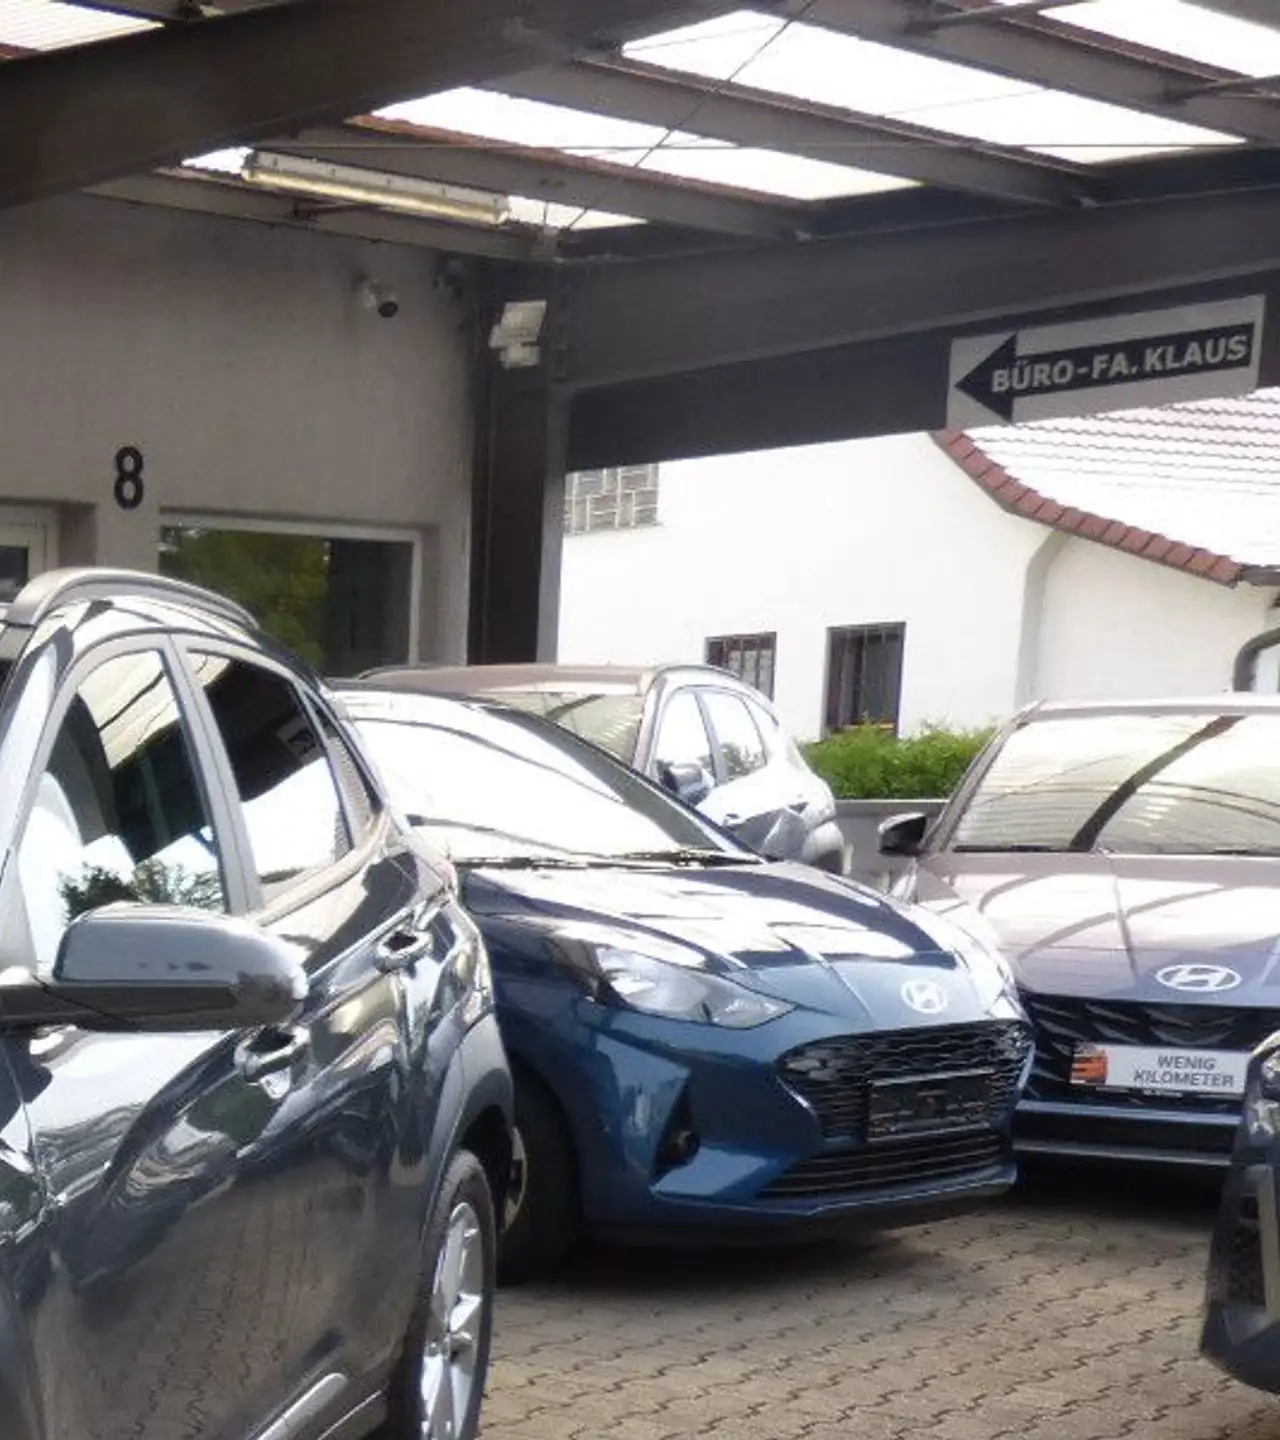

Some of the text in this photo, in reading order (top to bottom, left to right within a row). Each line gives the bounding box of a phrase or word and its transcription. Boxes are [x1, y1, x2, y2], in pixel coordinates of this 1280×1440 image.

[1143, 334, 1248, 371] KLAUS
[114, 446, 144, 510] 8
[1157, 1054, 1216, 1070] WENIG
[1133, 1067, 1234, 1087] KILOMETER
